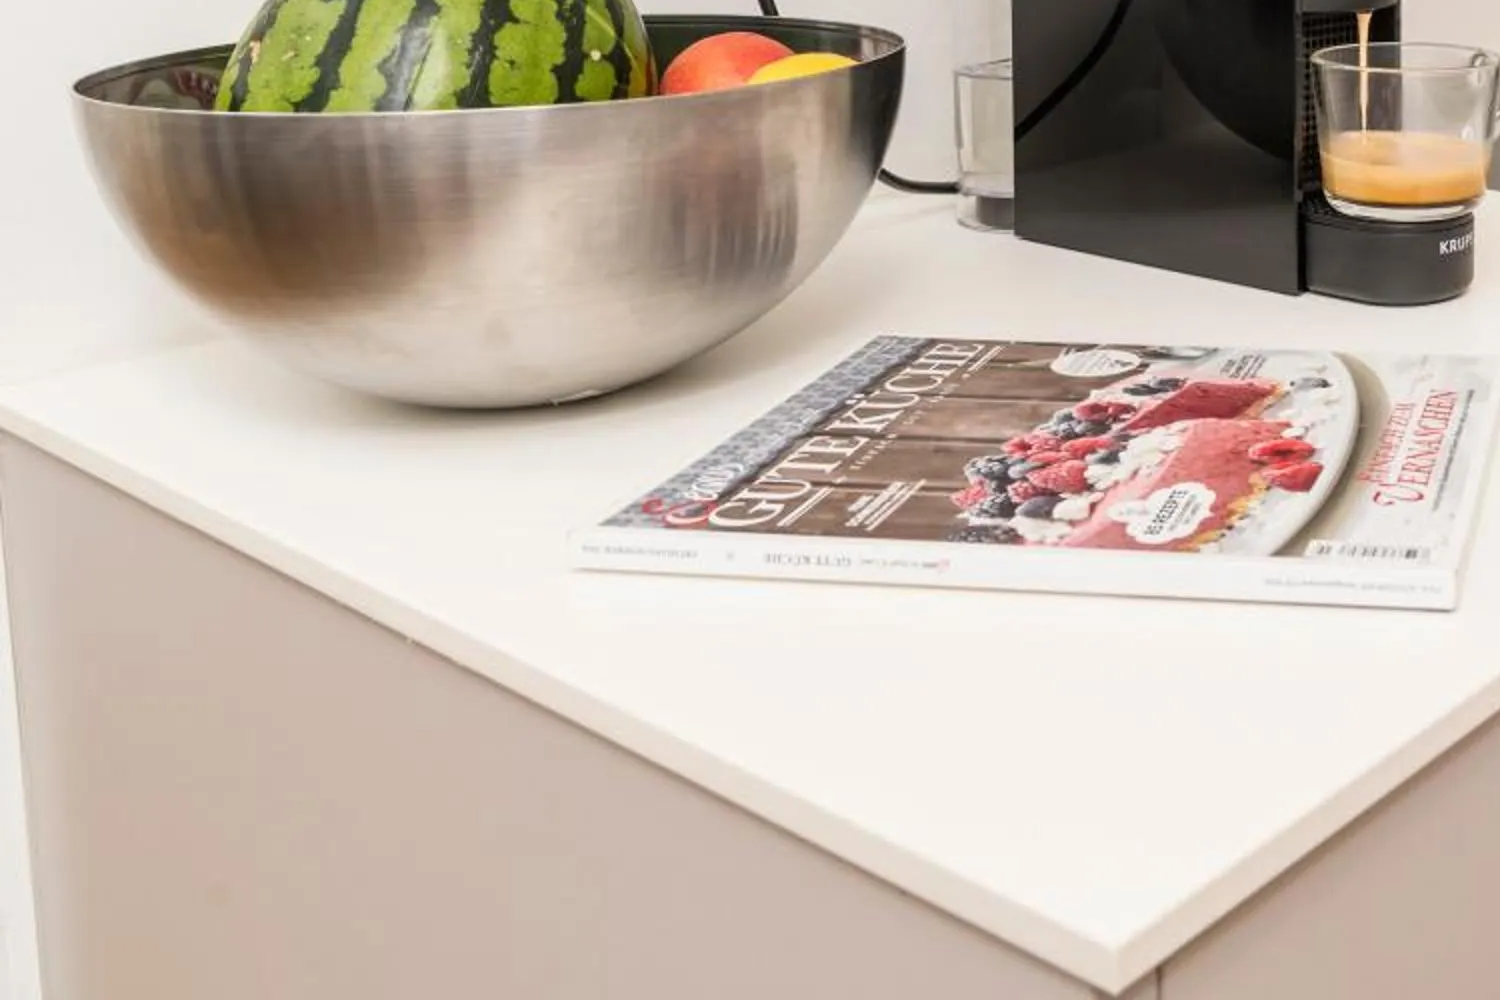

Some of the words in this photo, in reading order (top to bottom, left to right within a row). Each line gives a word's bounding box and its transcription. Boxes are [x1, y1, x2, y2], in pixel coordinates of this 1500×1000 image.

[1439, 233, 1474, 255] KRUP
[708, 435, 871, 527] GUTE
[825, 343, 985, 433] KÜCHE
[1373, 389, 1458, 507] VERNASCHEN
